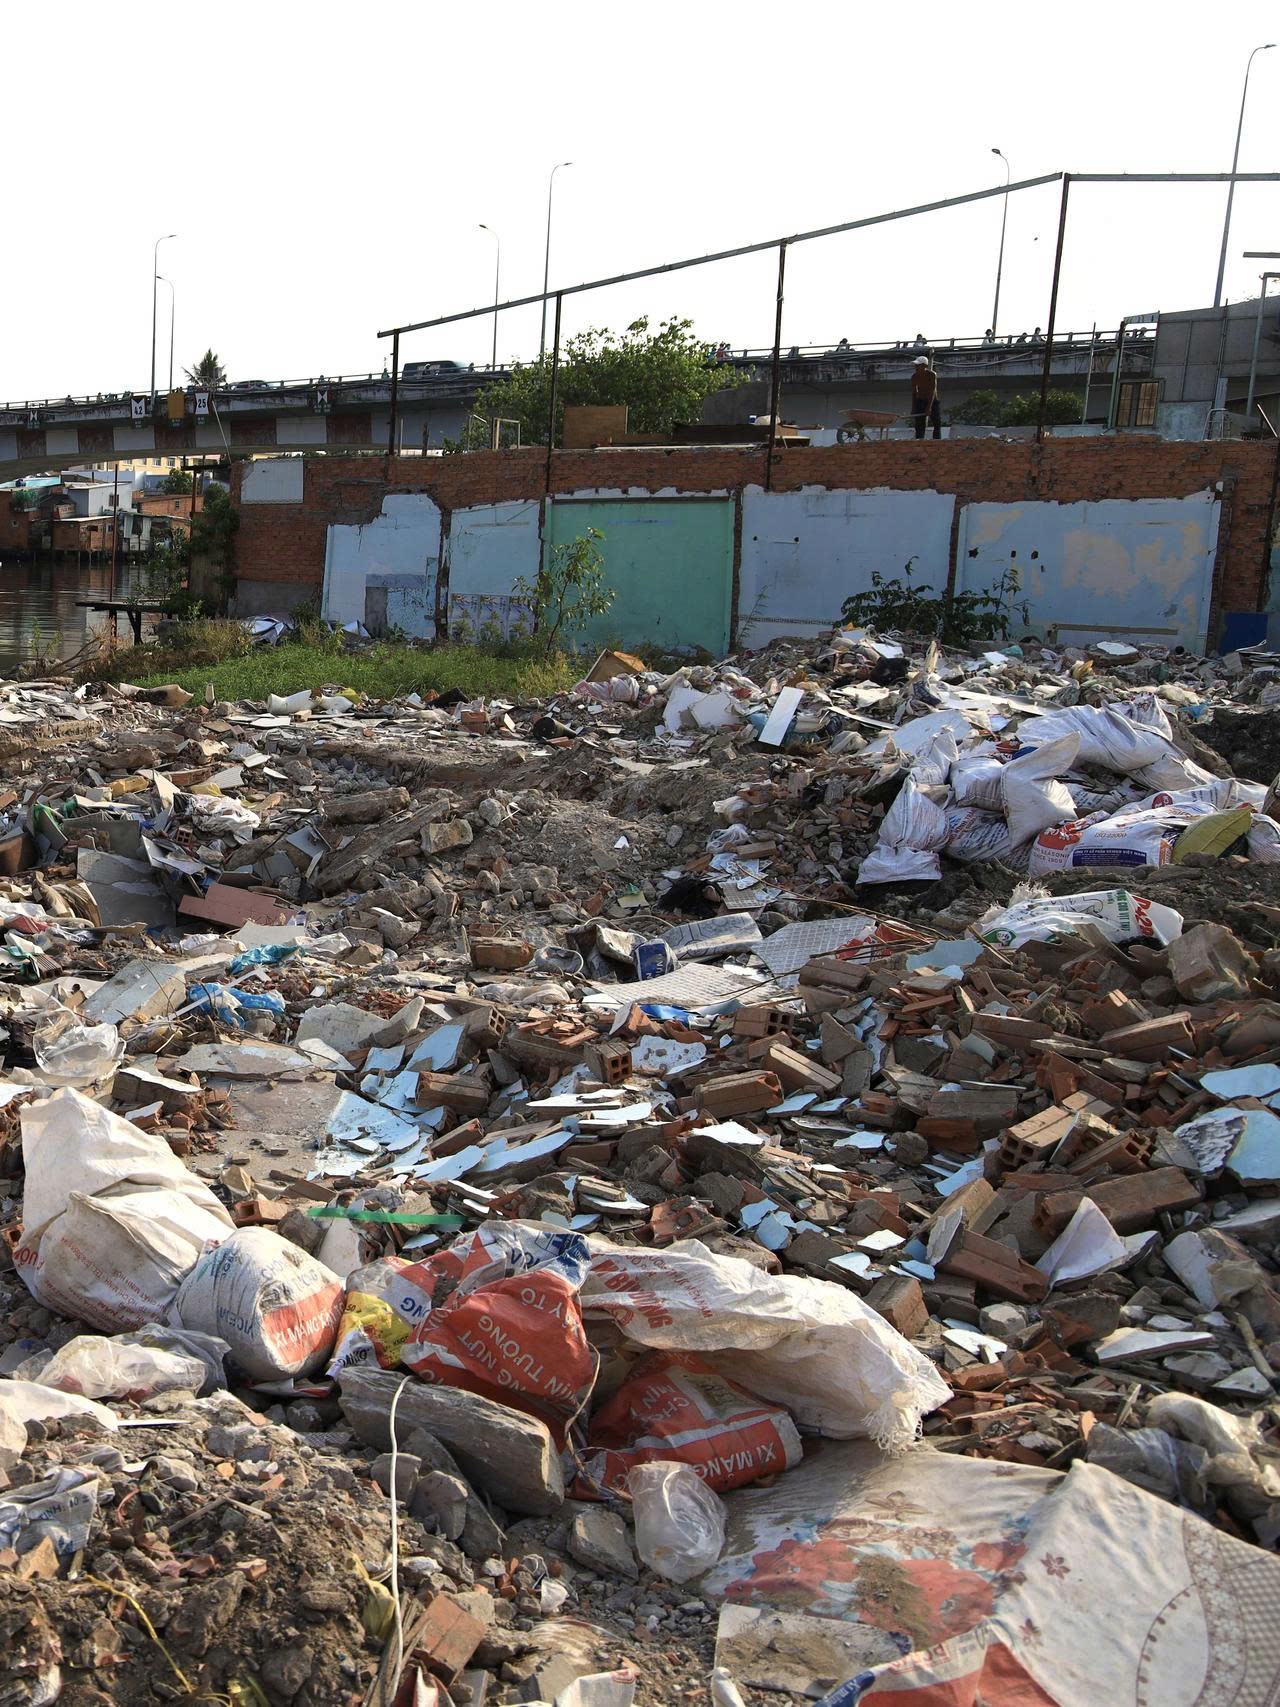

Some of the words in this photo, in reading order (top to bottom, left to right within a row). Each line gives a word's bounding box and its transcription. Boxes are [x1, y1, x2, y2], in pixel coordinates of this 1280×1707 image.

[457, 1330, 497, 1369] NỨT
[478, 1314, 545, 1382] TƯỜNG
[692, 1448, 753, 1480] MĂNG
